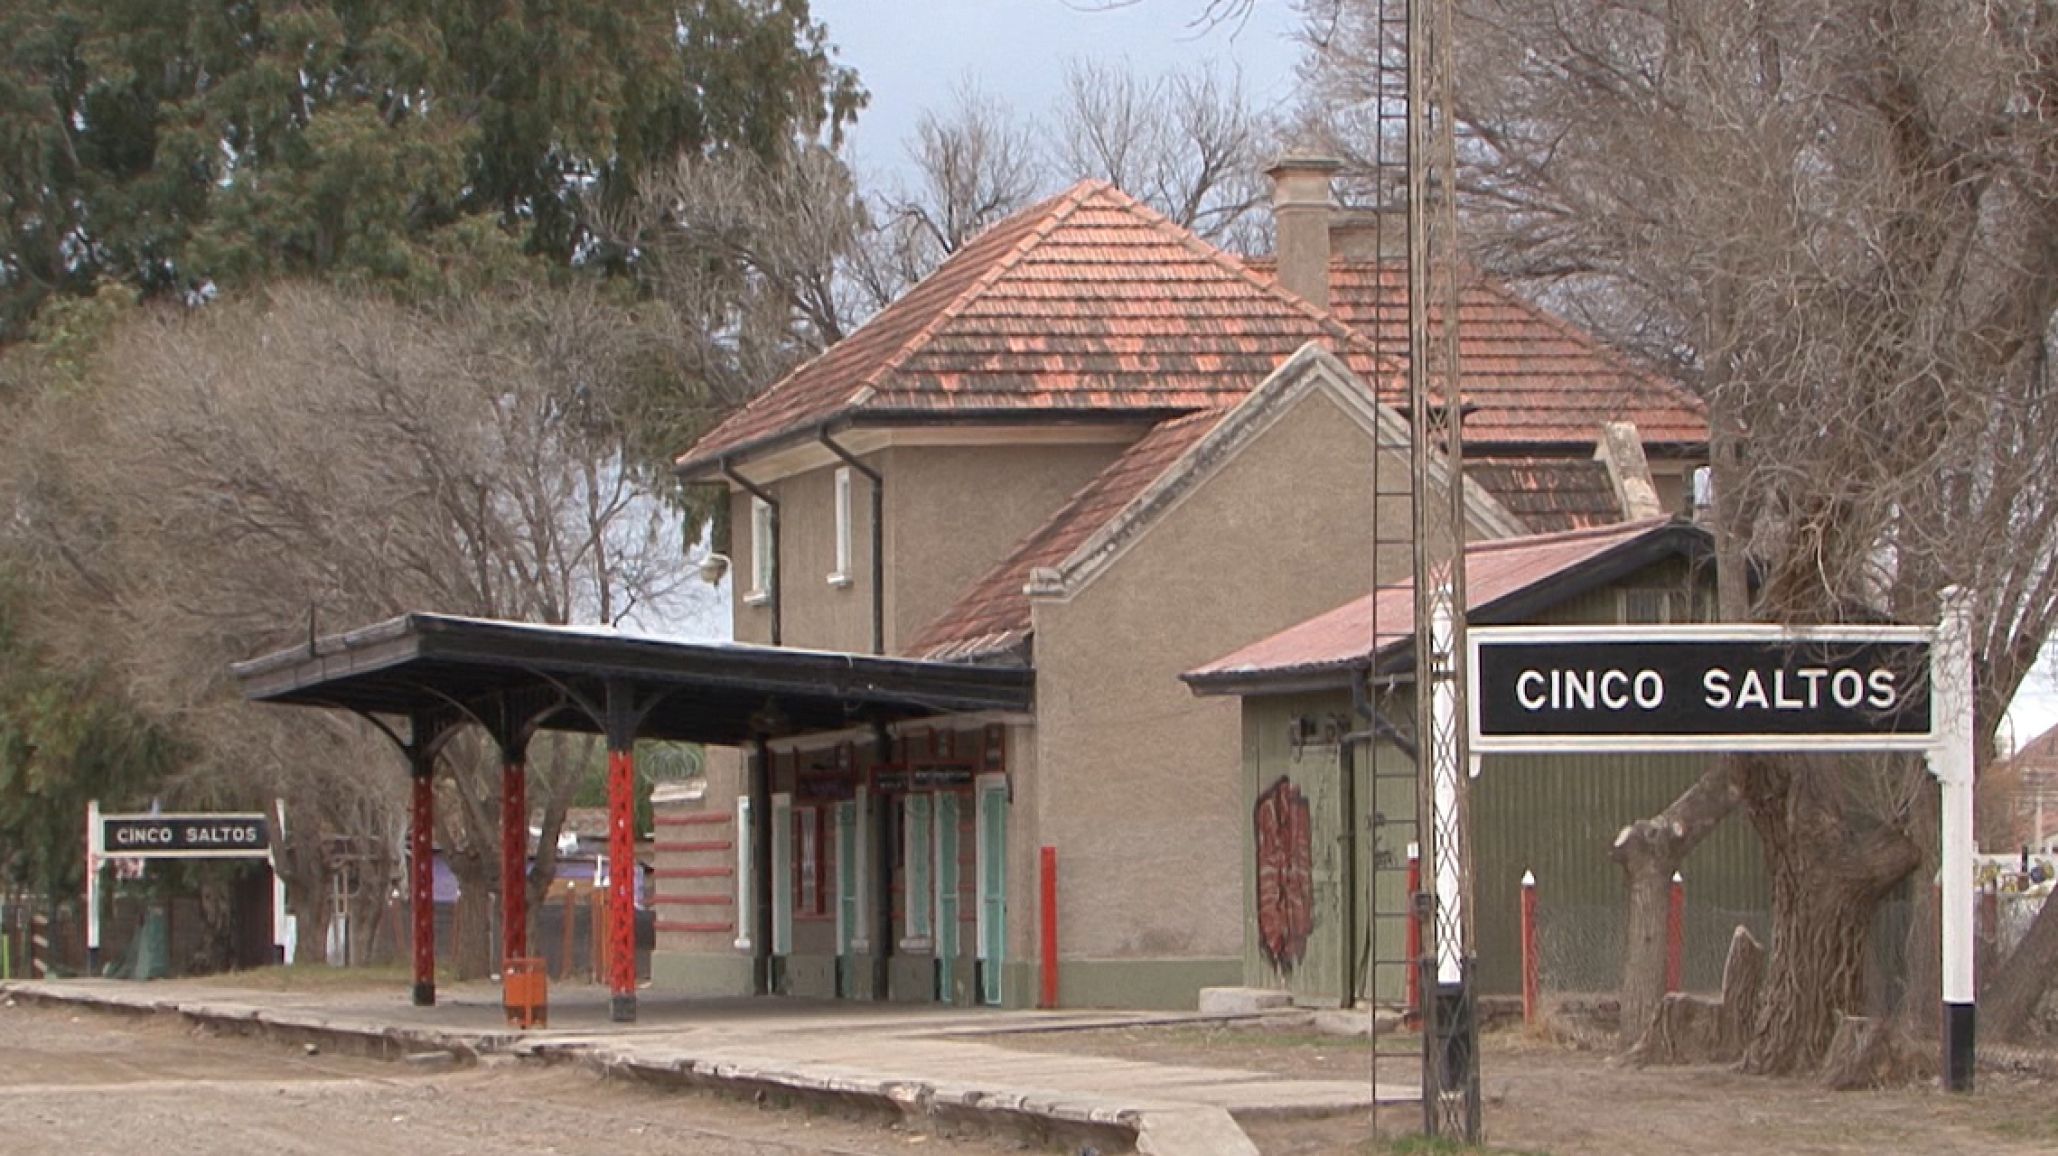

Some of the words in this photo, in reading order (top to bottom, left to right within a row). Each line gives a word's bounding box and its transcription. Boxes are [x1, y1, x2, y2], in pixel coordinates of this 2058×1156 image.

[1516, 669, 1664, 709] CINCO
[1703, 669, 1898, 709] SALTOS
[116, 826, 173, 844] CINCO
[185, 826, 258, 843] SALTOS
